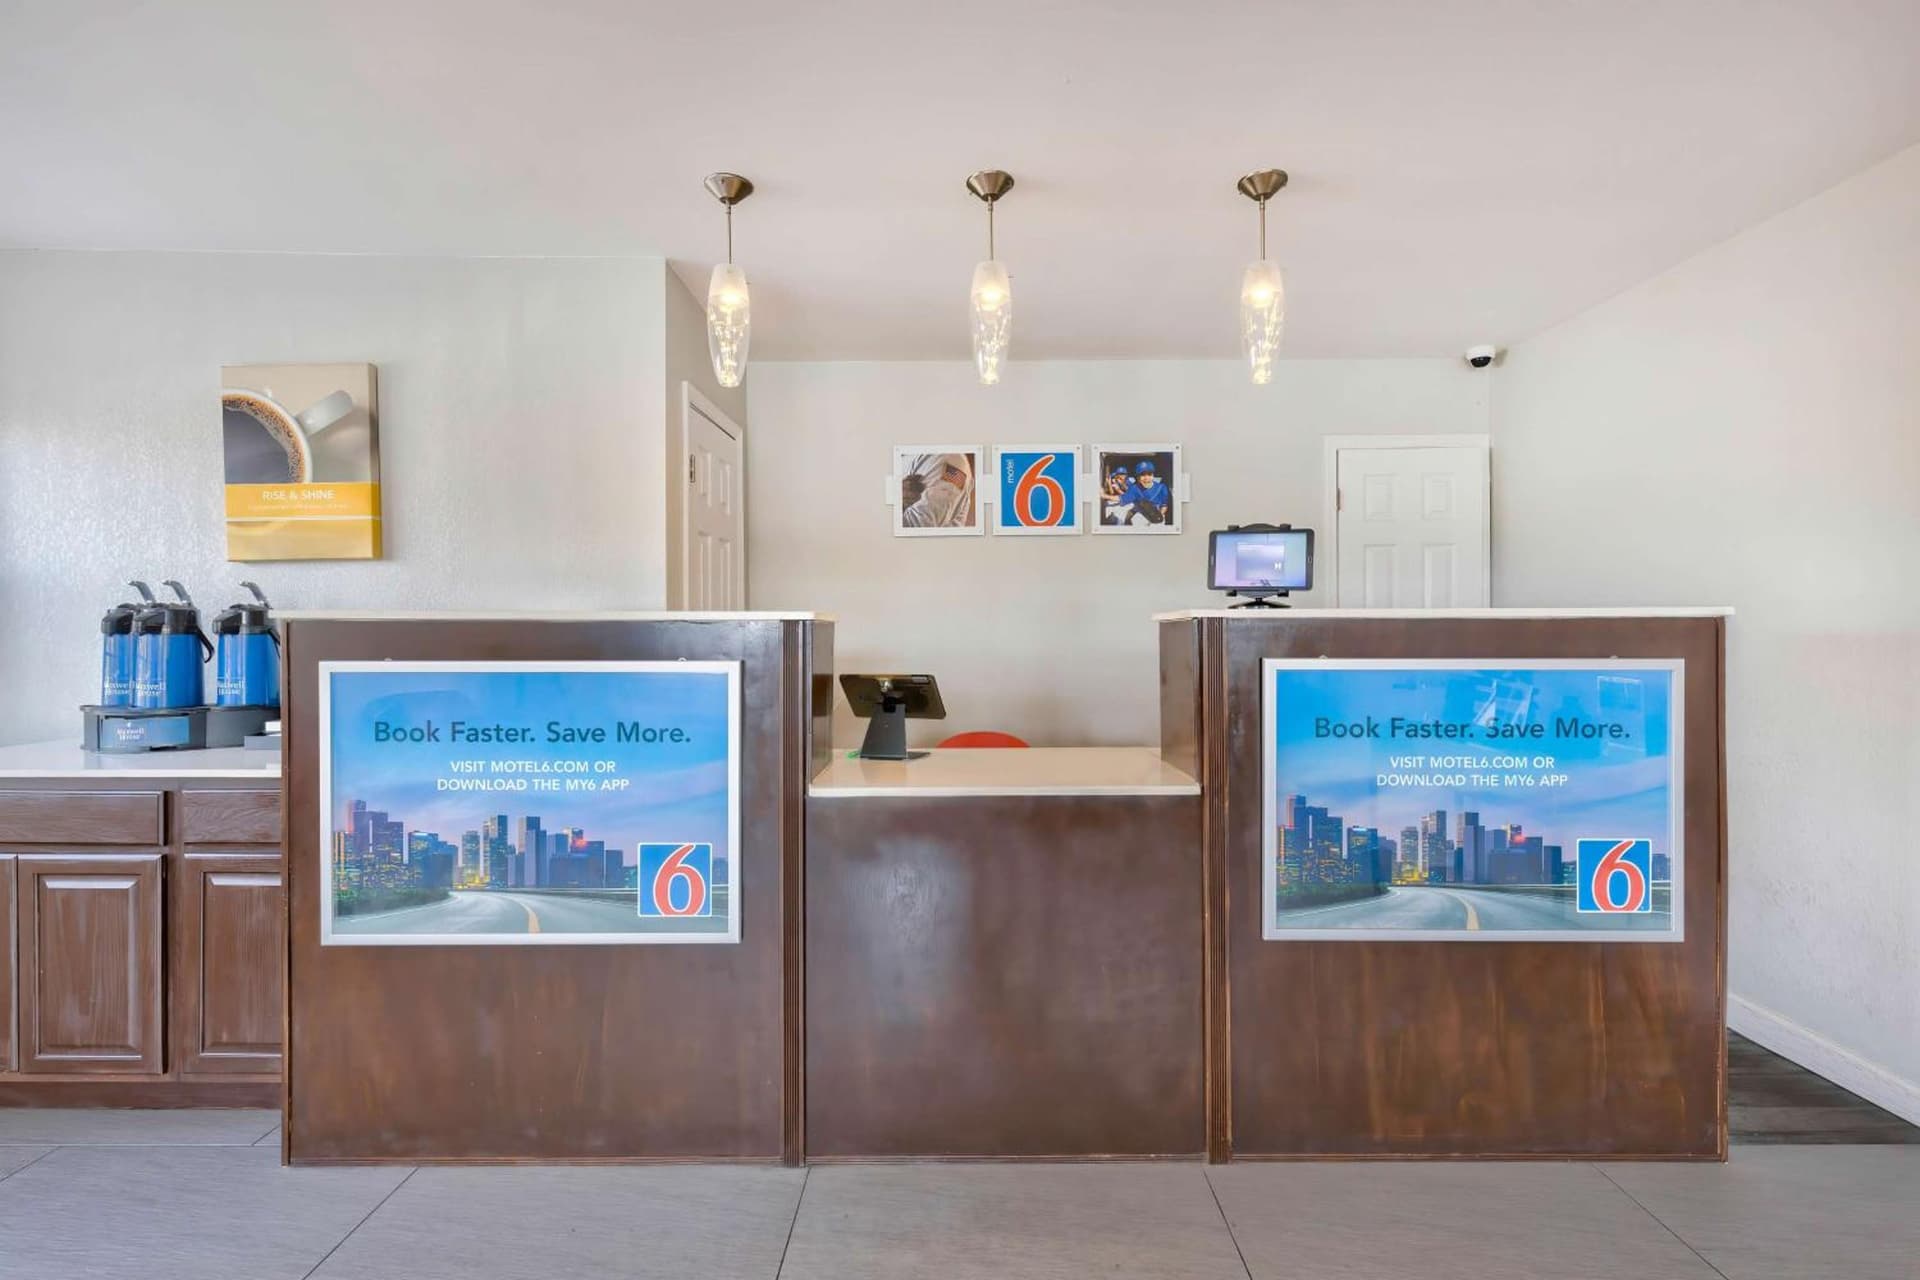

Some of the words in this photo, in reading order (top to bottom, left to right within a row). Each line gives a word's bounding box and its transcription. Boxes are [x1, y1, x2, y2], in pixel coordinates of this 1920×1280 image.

[1005, 458, 1015, 484] motel
[262, 490, 286, 501] RISE
[301, 489, 336, 500] SHINE
[1013, 454, 1066, 527] 6
[374, 719, 441, 743] Book
[450, 720, 536, 743] Faster.
[546, 720, 606, 743] Save
[616, 720, 692, 743] More.
[1314, 715, 1380, 739] Book
[1390, 716, 1474, 739] Faster.
[1485, 716, 1545, 739] Save
[1555, 716, 1631, 739] More.
[450, 760, 486, 773] VISIT
[490, 760, 589, 773] MOTEL6.COM
[594, 760, 616, 773] OR
[1389, 756, 1426, 769] VISIT
[1430, 756, 1528, 769] MOTEL6.COM
[1533, 756, 1555, 769] OR
[437, 778, 528, 791] DOWNLOAD
[532, 778, 561, 791] THE
[566, 778, 597, 791] MY6
[600, 778, 630, 791] APP
[1376, 774, 1466, 787] DOWNLOAD
[1471, 774, 1499, 787] THE
[1504, 774, 1535, 787] MY6
[1539, 774, 1568, 787] APP
[652, 843, 707, 917] 6
[1591, 838, 1646, 912] 6
